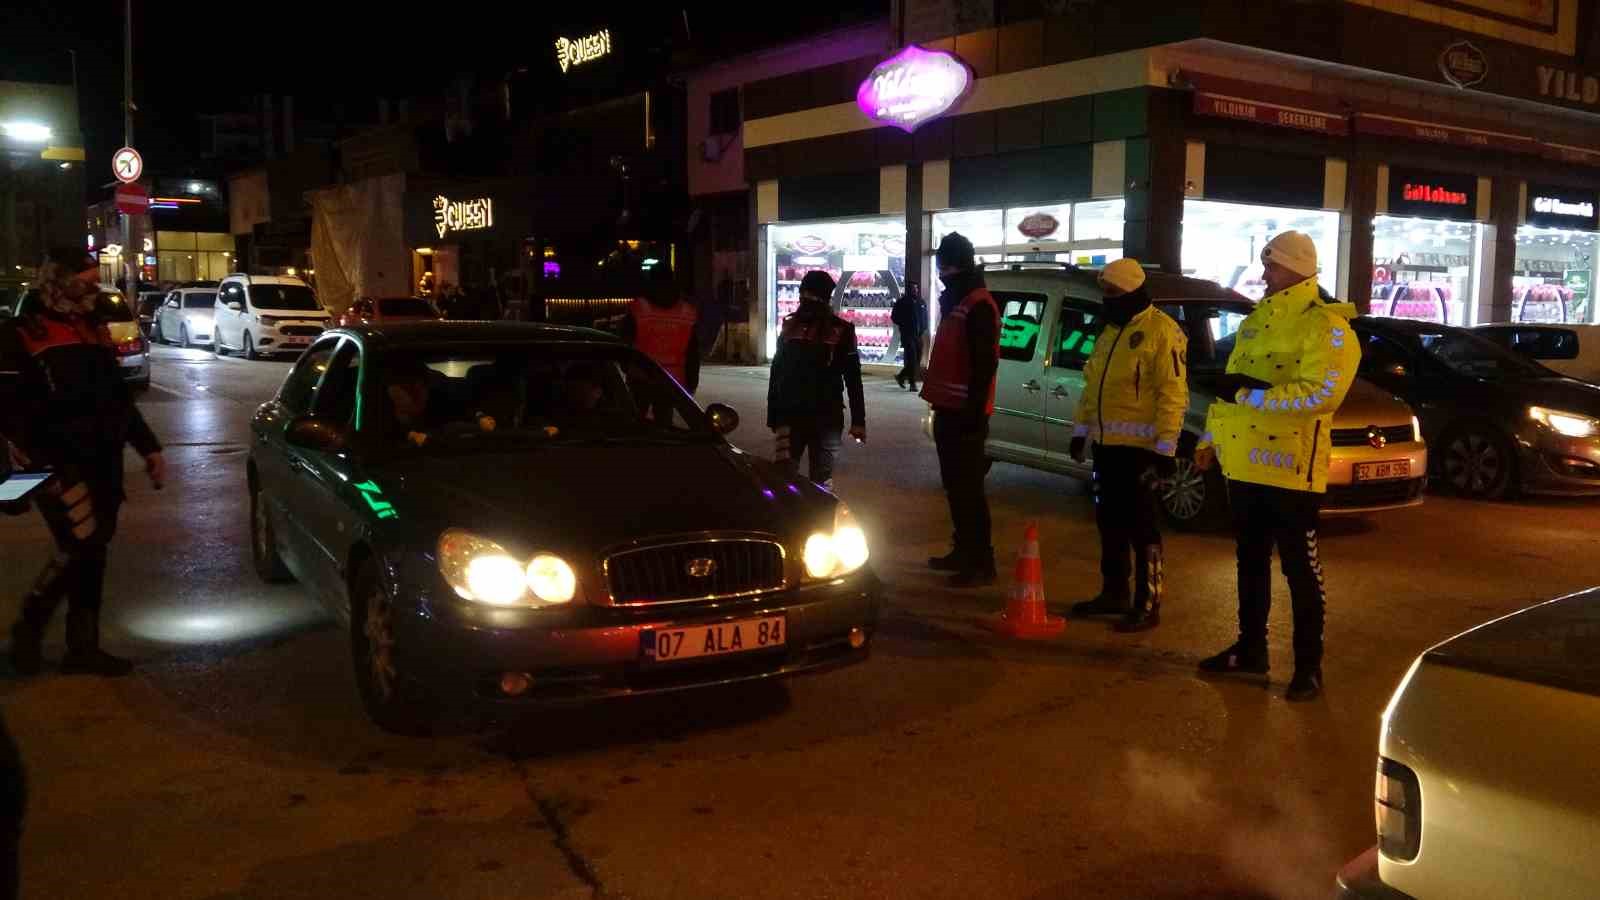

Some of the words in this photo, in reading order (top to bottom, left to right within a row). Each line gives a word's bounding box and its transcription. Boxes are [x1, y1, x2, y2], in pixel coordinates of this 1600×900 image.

[569, 29, 610, 65] QUEEN
[447, 198, 493, 231] QUEEN
[658, 632, 685, 658] 07
[704, 625, 743, 653] ALA
[758, 620, 781, 646] 84
